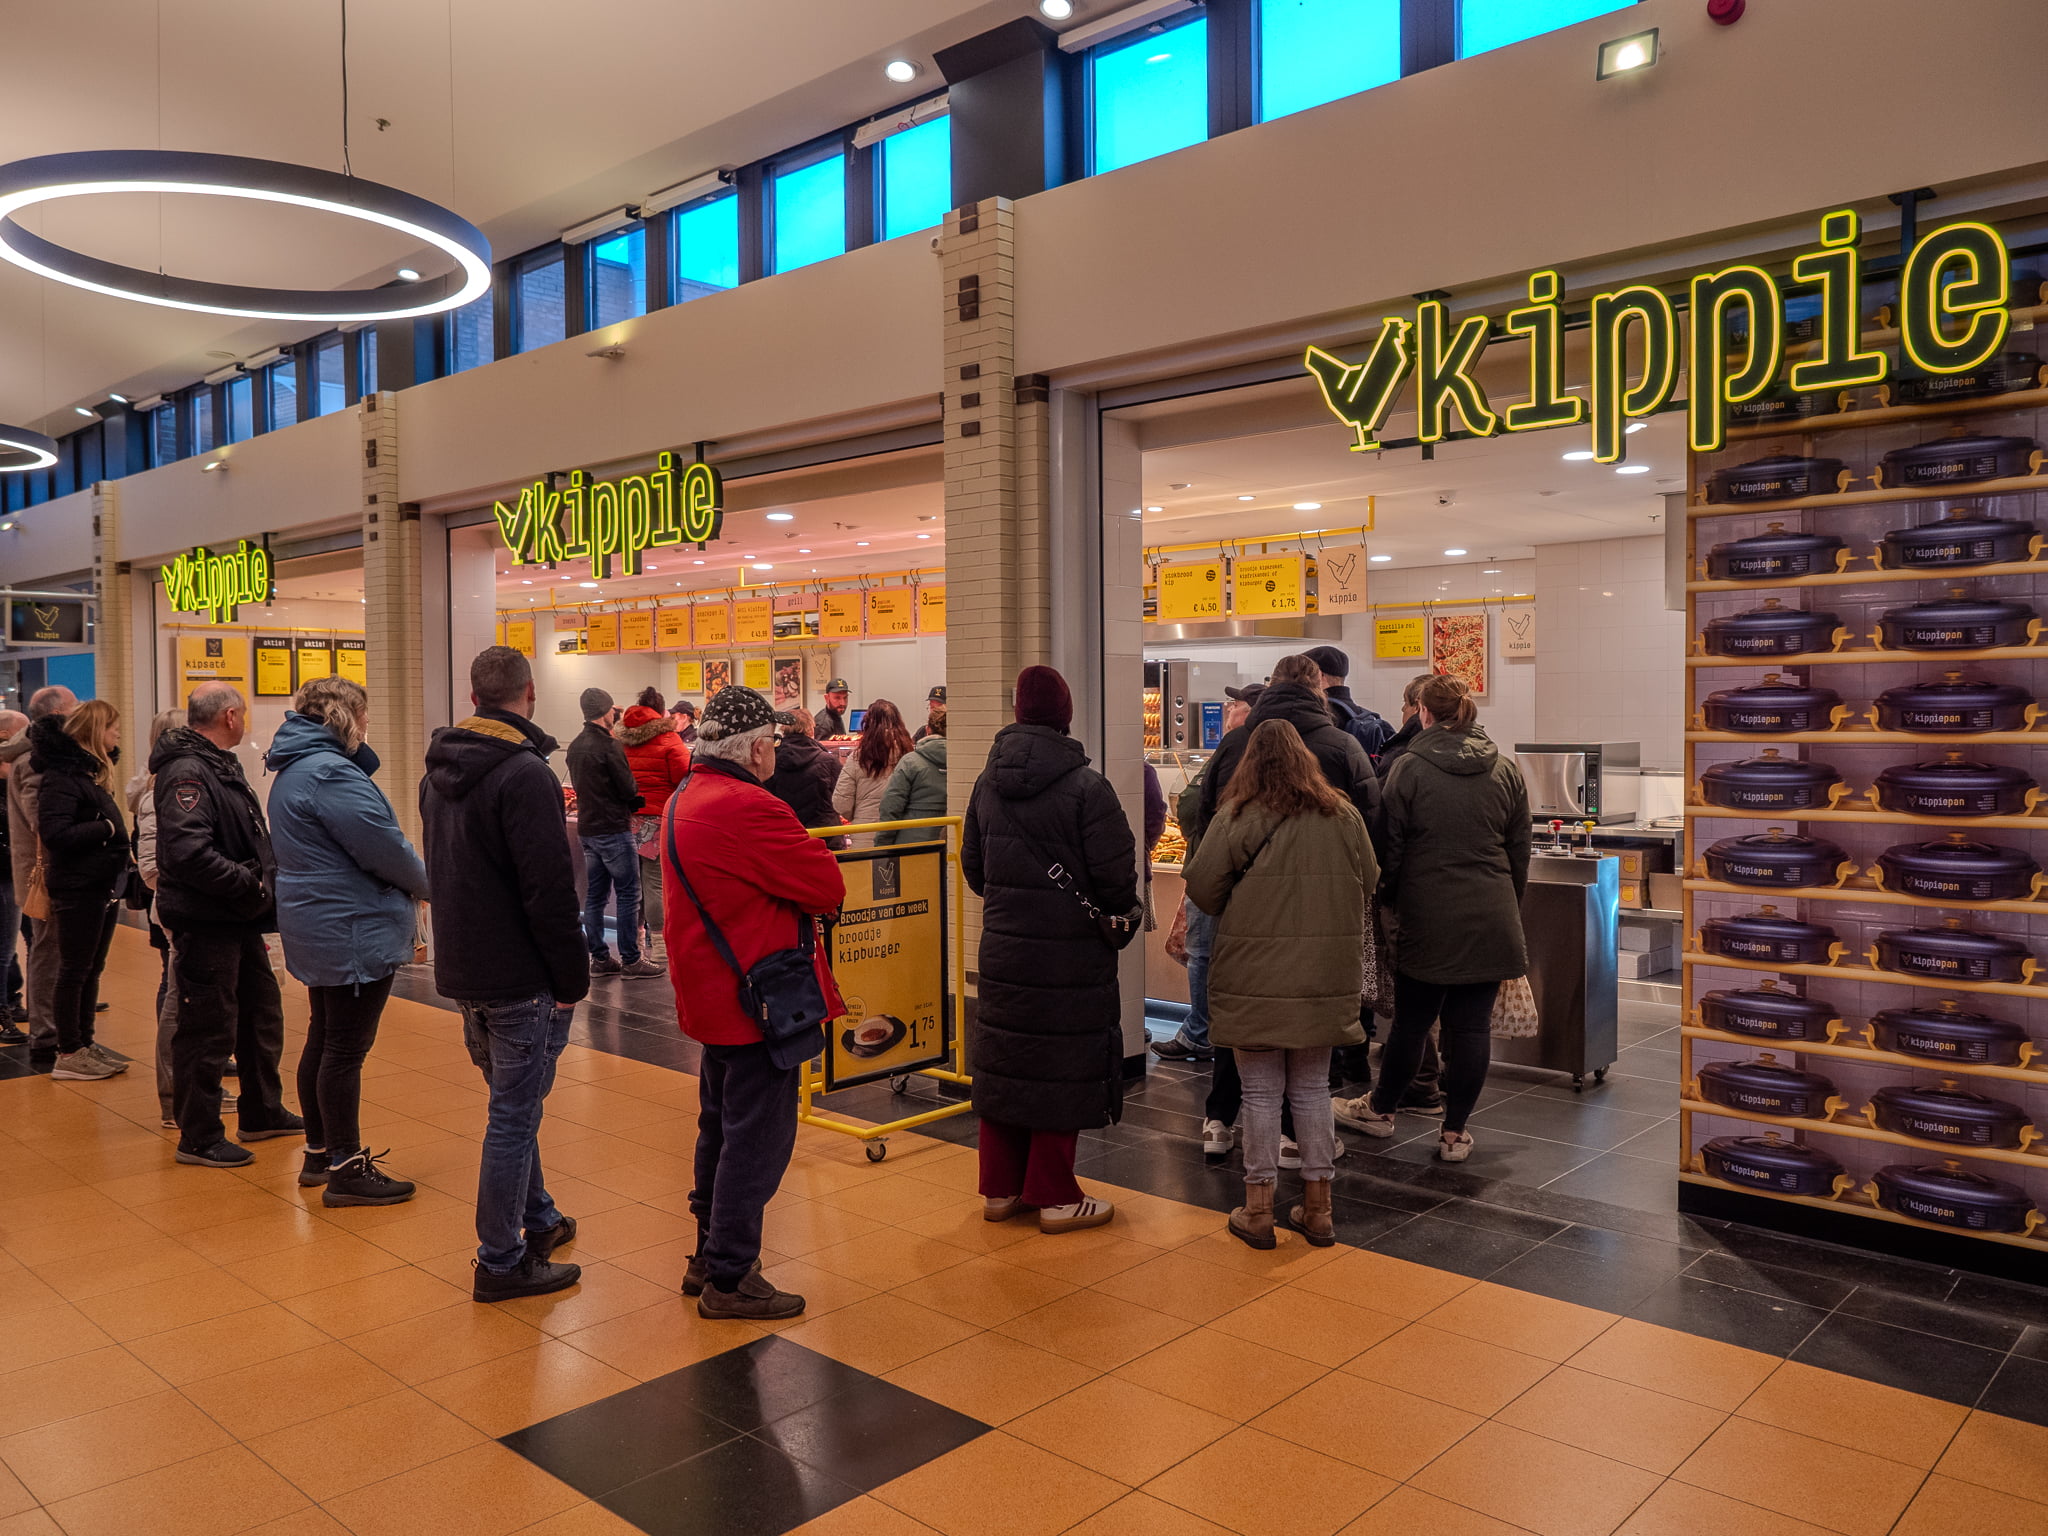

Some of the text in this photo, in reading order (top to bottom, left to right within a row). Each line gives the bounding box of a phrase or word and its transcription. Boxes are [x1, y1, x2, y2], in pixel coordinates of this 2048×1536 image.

[1418, 209, 2010, 462] kippie
[1929, 376, 1976, 391] kippiepan
[1743, 400, 1785, 413] kippiepan
[1918, 463, 1964, 477] kippiepan
[1740, 481, 1780, 493] kippiepan
[534, 452, 715, 579] kippie
[1915, 546, 1961, 559] kippiepan
[1740, 559, 1781, 571] kippiepan
[1164, 570, 1193, 579] stokbrood
[180, 540, 269, 624] kippie
[871, 596, 877, 609] 5
[922, 592, 928, 605] 3
[1271, 598, 1296, 608] € 1,75
[1329, 594, 1358, 605] kippie
[823, 600, 829, 612] 5
[1193, 602, 1217, 612] € 4,50
[840, 625, 844, 633] €
[892, 622, 908, 630] € 7,00
[1917, 630, 1962, 642] kippiepan
[1408, 645, 1421, 653] 7,50
[1734, 637, 1774, 649] kippiepan
[261, 652, 267, 662] 5
[340, 652, 346, 663] 5
[185, 659, 226, 669] kipsaté
[1740, 713, 1781, 725] kippiepan
[1915, 713, 1960, 725] kippiepan
[1743, 792, 1784, 803] kippiepan
[1919, 796, 1965, 808] kippiepan
[1734, 864, 1773, 877] kippiepan
[1915, 878, 1960, 892] kippiepan
[840, 901, 928, 924] Broodje van de week
[839, 927, 881, 944] broodje
[839, 942, 901, 963] kipburger
[1731, 940, 1771, 954] kippiepan
[1912, 955, 1958, 969] kippiepan
[1737, 1016, 1777, 1030] kippiepan
[1910, 1037, 1956, 1051] kippiepan
[1740, 1094, 1781, 1107] kippiepan
[1914, 1120, 1960, 1135] kippiepan
[1731, 1163, 1770, 1179] kippiepan
[1910, 1200, 1955, 1218] kippiepan
